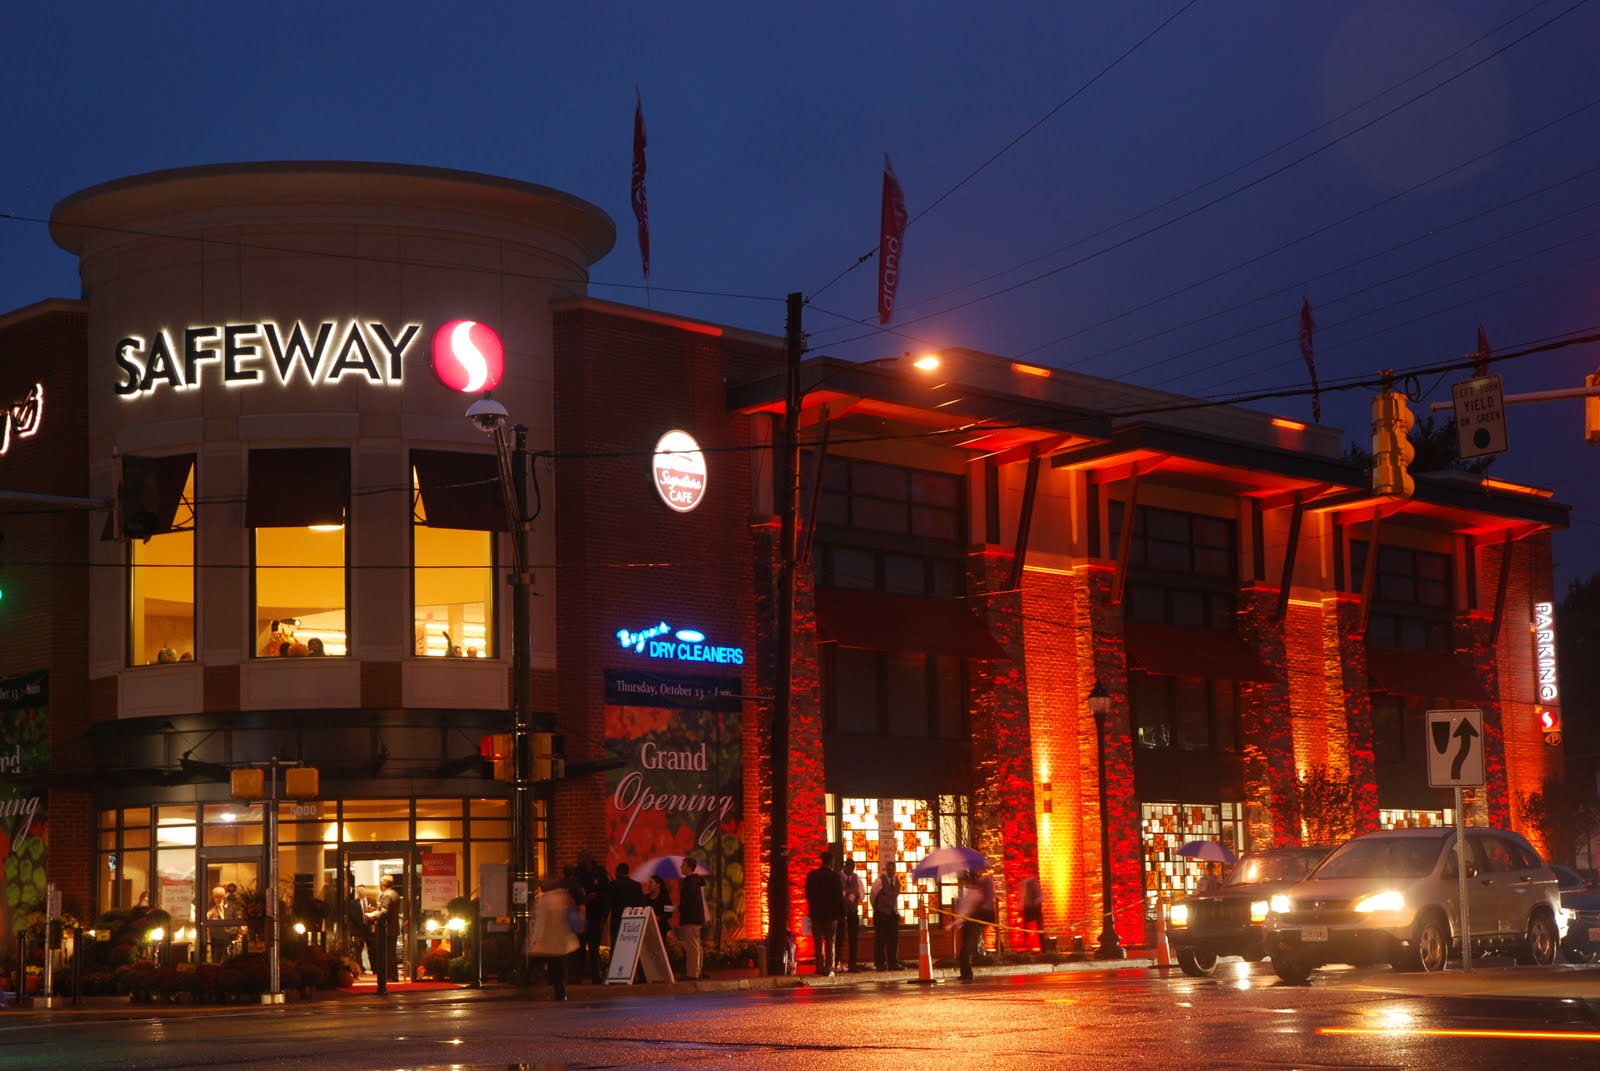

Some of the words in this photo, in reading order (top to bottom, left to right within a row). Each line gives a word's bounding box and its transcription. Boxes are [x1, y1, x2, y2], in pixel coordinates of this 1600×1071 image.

[114, 319, 423, 399] SAFEWAY
[1464, 396, 1494, 412] YIELD
[1460, 416, 1470, 427] ON
[1477, 411, 1501, 424] GREEN
[649, 641, 676, 659] DRY
[677, 643, 744, 665] CLEANERS
[1536, 602, 1557, 700] PARKING
[616, 680, 658, 695] Thursday,
[660, 683, 692, 696] October
[695, 690, 704, 700] 13
[640, 742, 708, 772] Grand
[289, 805, 317, 816] 5000
[613, 771, 734, 846] Opening
